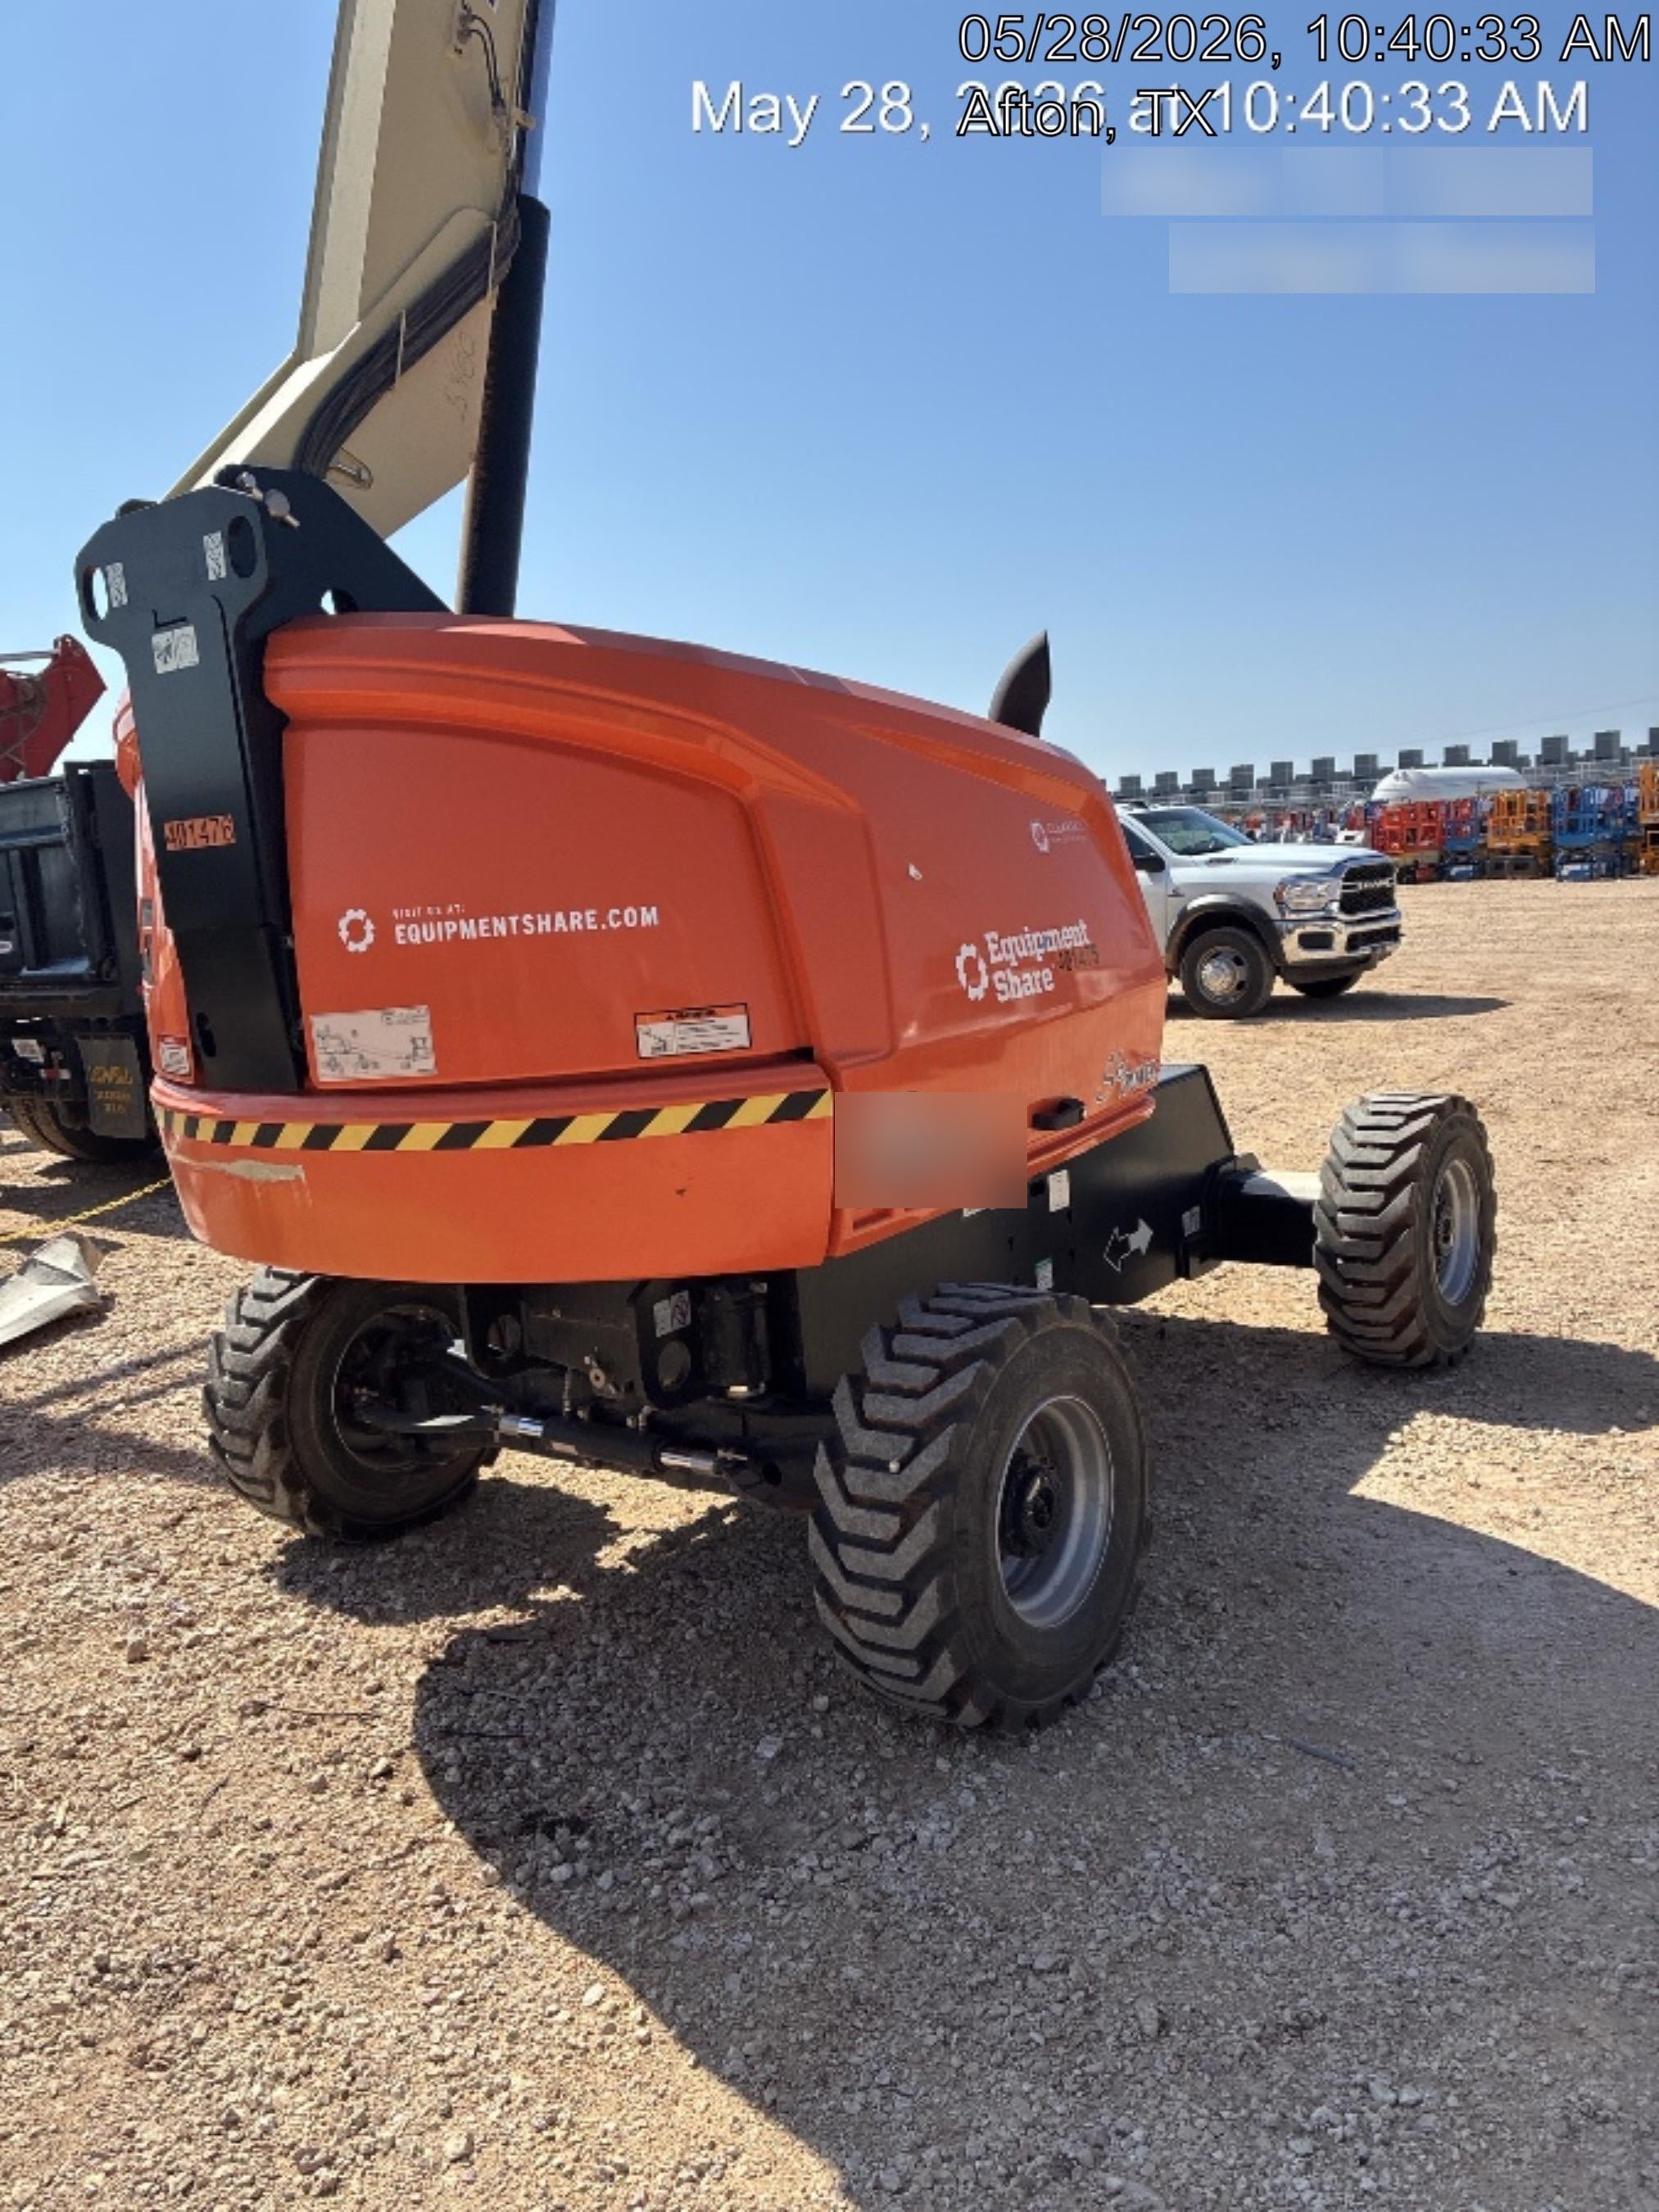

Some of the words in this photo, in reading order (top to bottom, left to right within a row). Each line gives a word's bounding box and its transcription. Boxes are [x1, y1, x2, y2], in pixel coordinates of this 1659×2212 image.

[395, 906, 660, 944] EQUIPMENTSHARE.COM
[983, 918, 1090, 967] Equipment
[992, 968, 1055, 1004] Share
